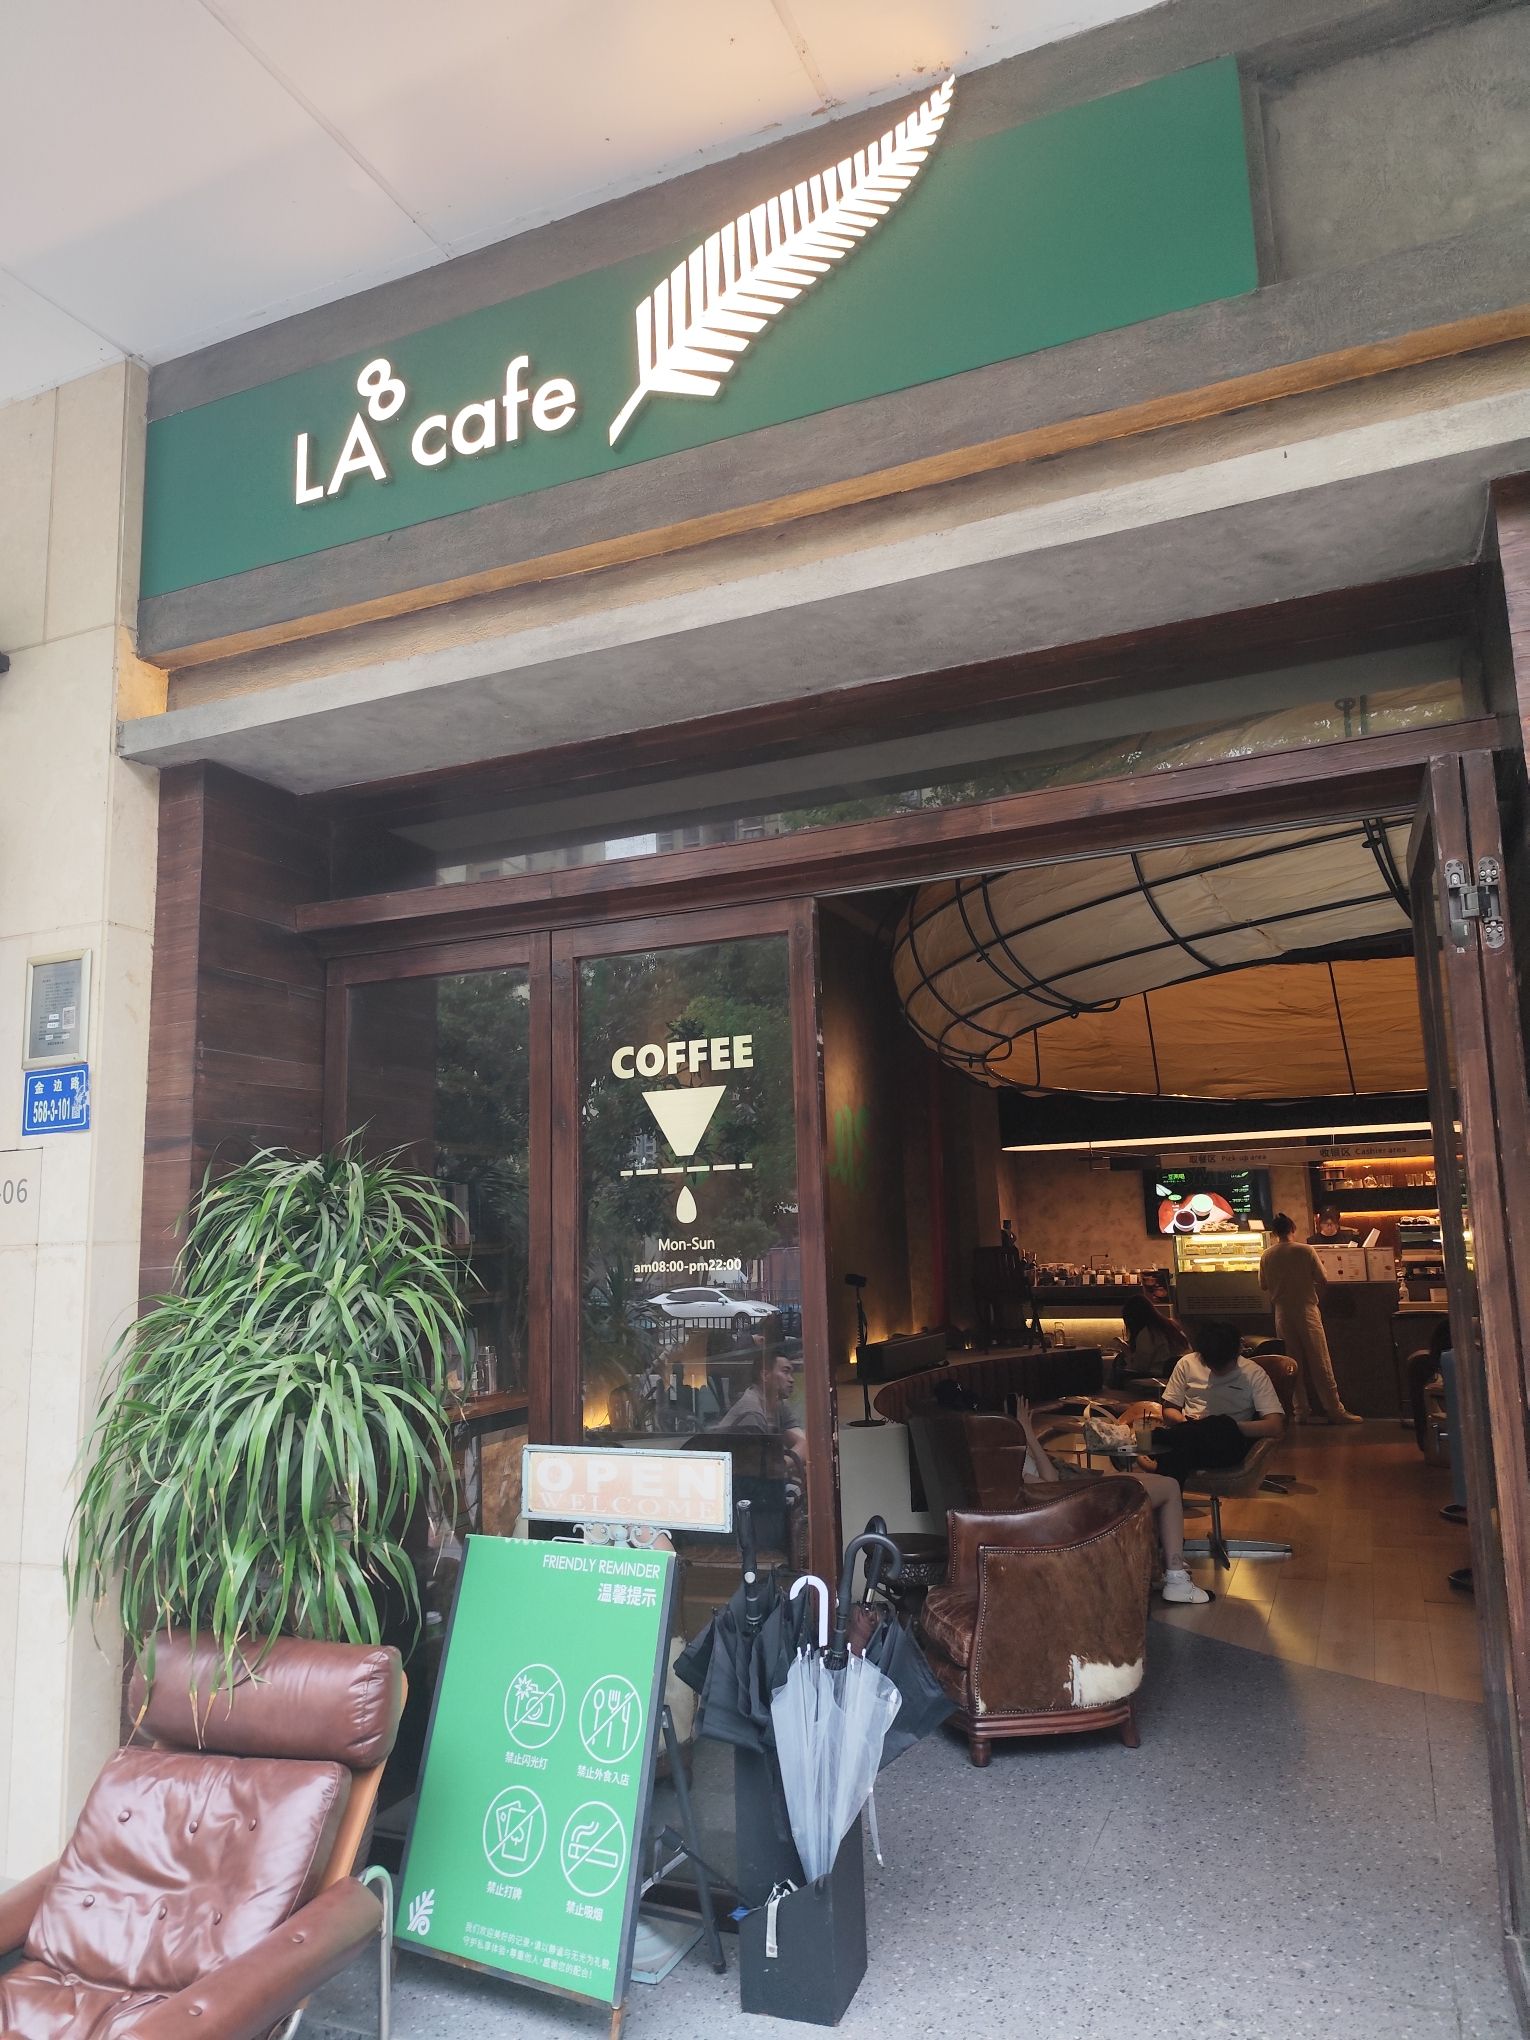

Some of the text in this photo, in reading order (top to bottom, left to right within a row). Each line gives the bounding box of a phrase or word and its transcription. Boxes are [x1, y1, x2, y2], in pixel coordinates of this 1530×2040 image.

[411, 355, 577, 467] cafe
[611, 1034, 754, 1079] COFFEE
[34, 1076, 80, 1095] 金边路
[33, 1097, 71, 1124] 568-3-101
[1387, 1146, 1407, 1154] area
[0, 1178, 28, 1205] 06
[658, 1236, 715, 1252] Mon-Sun
[633, 1256, 742, 1275] am08:00-pm22:00
[536, 1457, 718, 1500] OPEN
[537, 1492, 716, 1521] WELCOME
[542, 1554, 661, 1579] FRIENDLY REMINDER
[597, 1582, 657, 1608] 温馨提示
[504, 1750, 549, 1770] 禁止闪光灯
[576, 1764, 631, 1787] 禁止外食入店
[486, 1880, 523, 1902] 禁止打牌
[566, 1899, 604, 1922] 禁止吸烟
